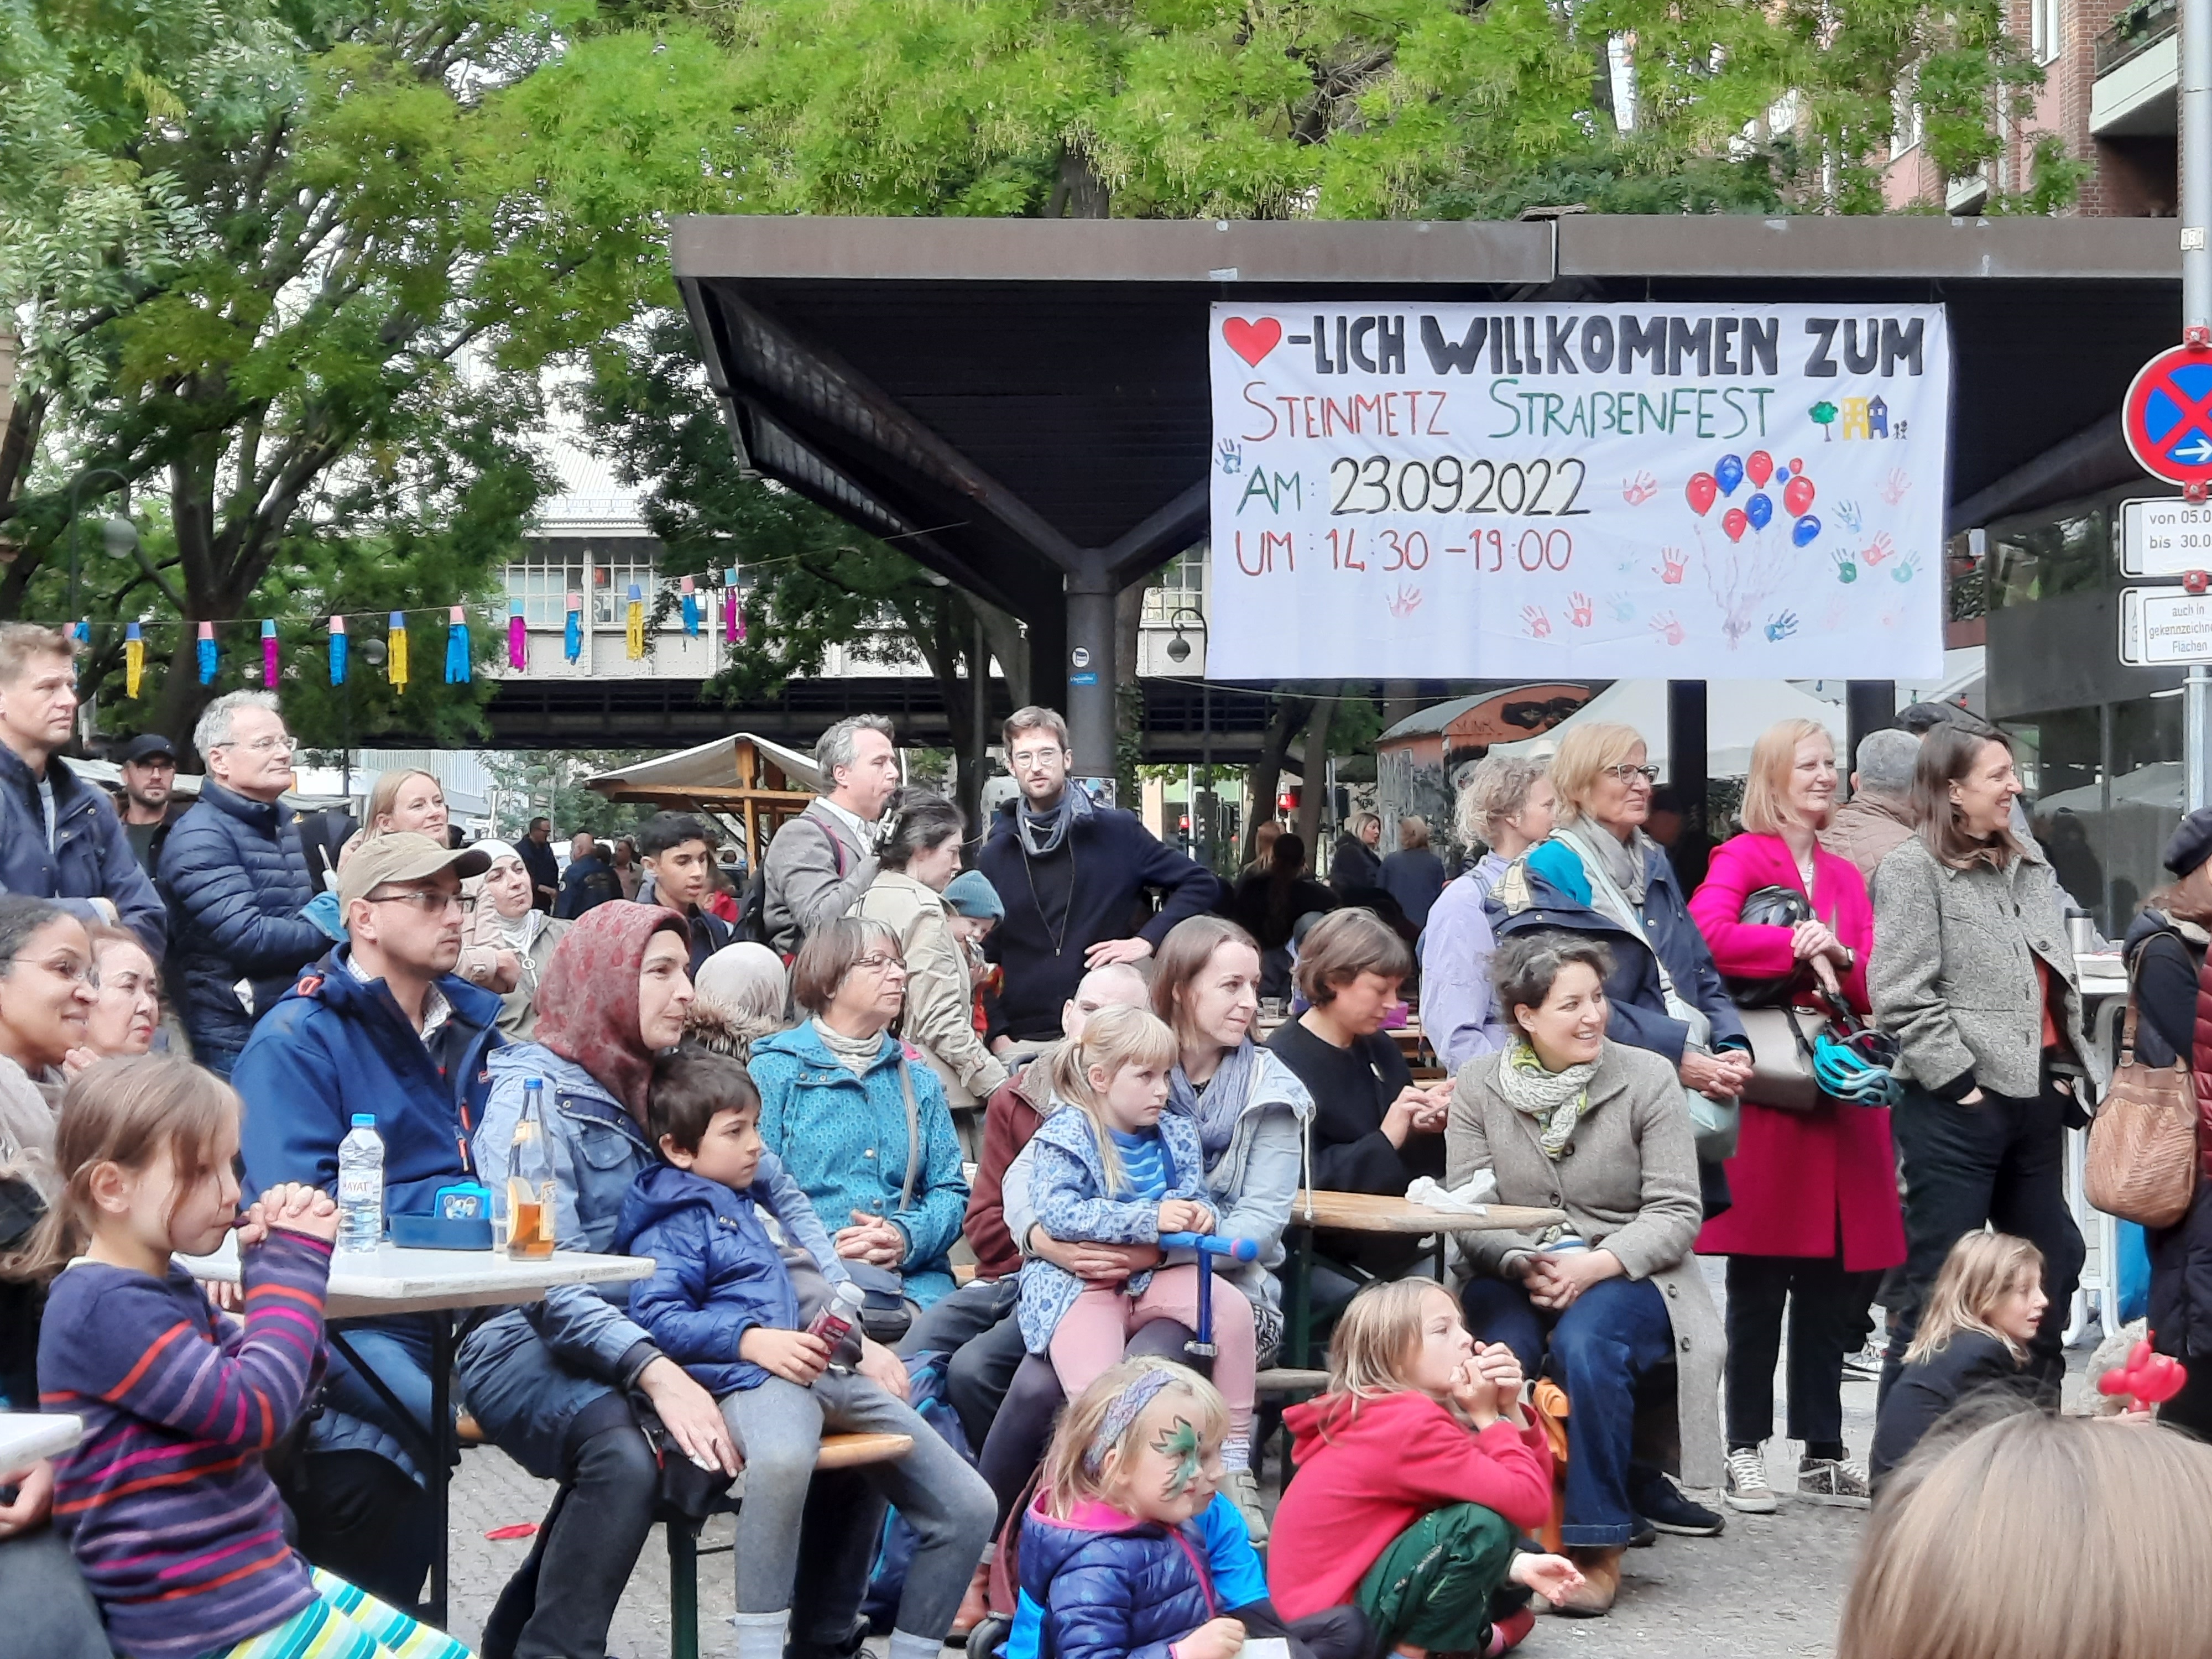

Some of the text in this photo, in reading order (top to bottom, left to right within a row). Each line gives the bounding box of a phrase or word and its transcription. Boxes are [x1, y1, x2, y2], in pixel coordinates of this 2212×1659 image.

[1420, 315, 1778, 377] WILLKOMMEN
[1804, 318, 1924, 377] ZUM
[1241, 381, 1449, 441] STEINMETZ
[2150, 514, 2176, 525] von
[1324, 528, 1429, 571] 14:30
[2150, 534, 2212, 549] bis 30.0
[2172, 603, 2194, 617] auch
